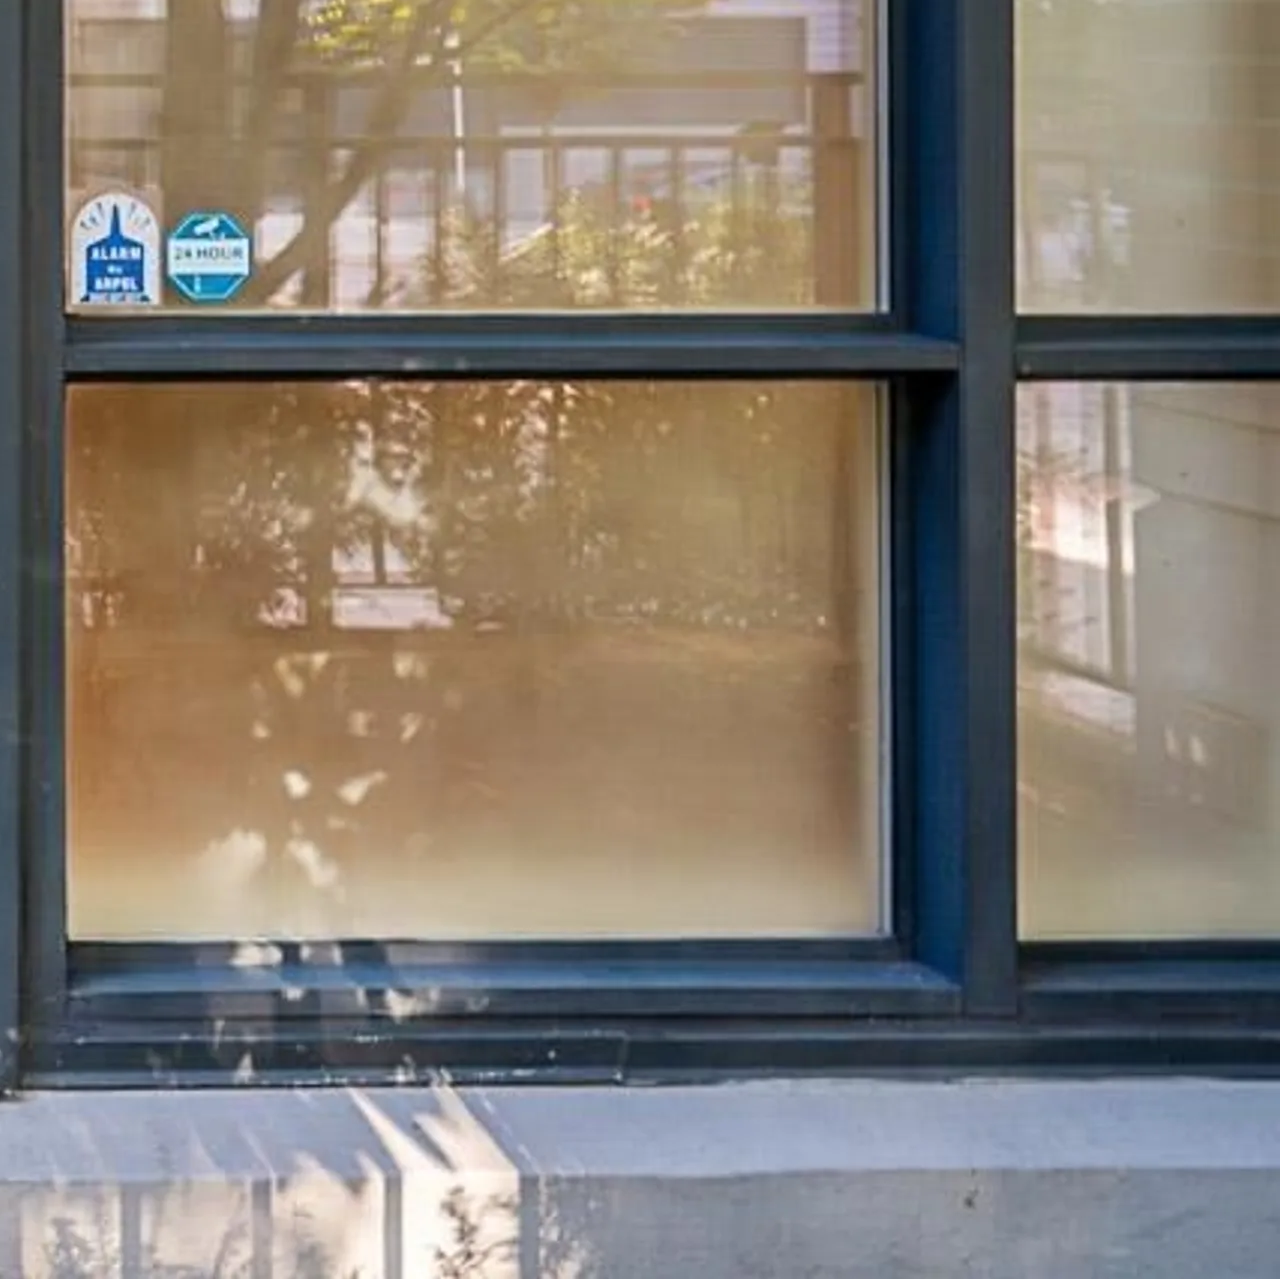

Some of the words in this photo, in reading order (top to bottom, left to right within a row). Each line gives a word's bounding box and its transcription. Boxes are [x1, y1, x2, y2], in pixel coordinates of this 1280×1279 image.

[91, 246, 141, 260] ALARM
[174, 247, 192, 260] 24
[197, 247, 244, 260] HOUR
